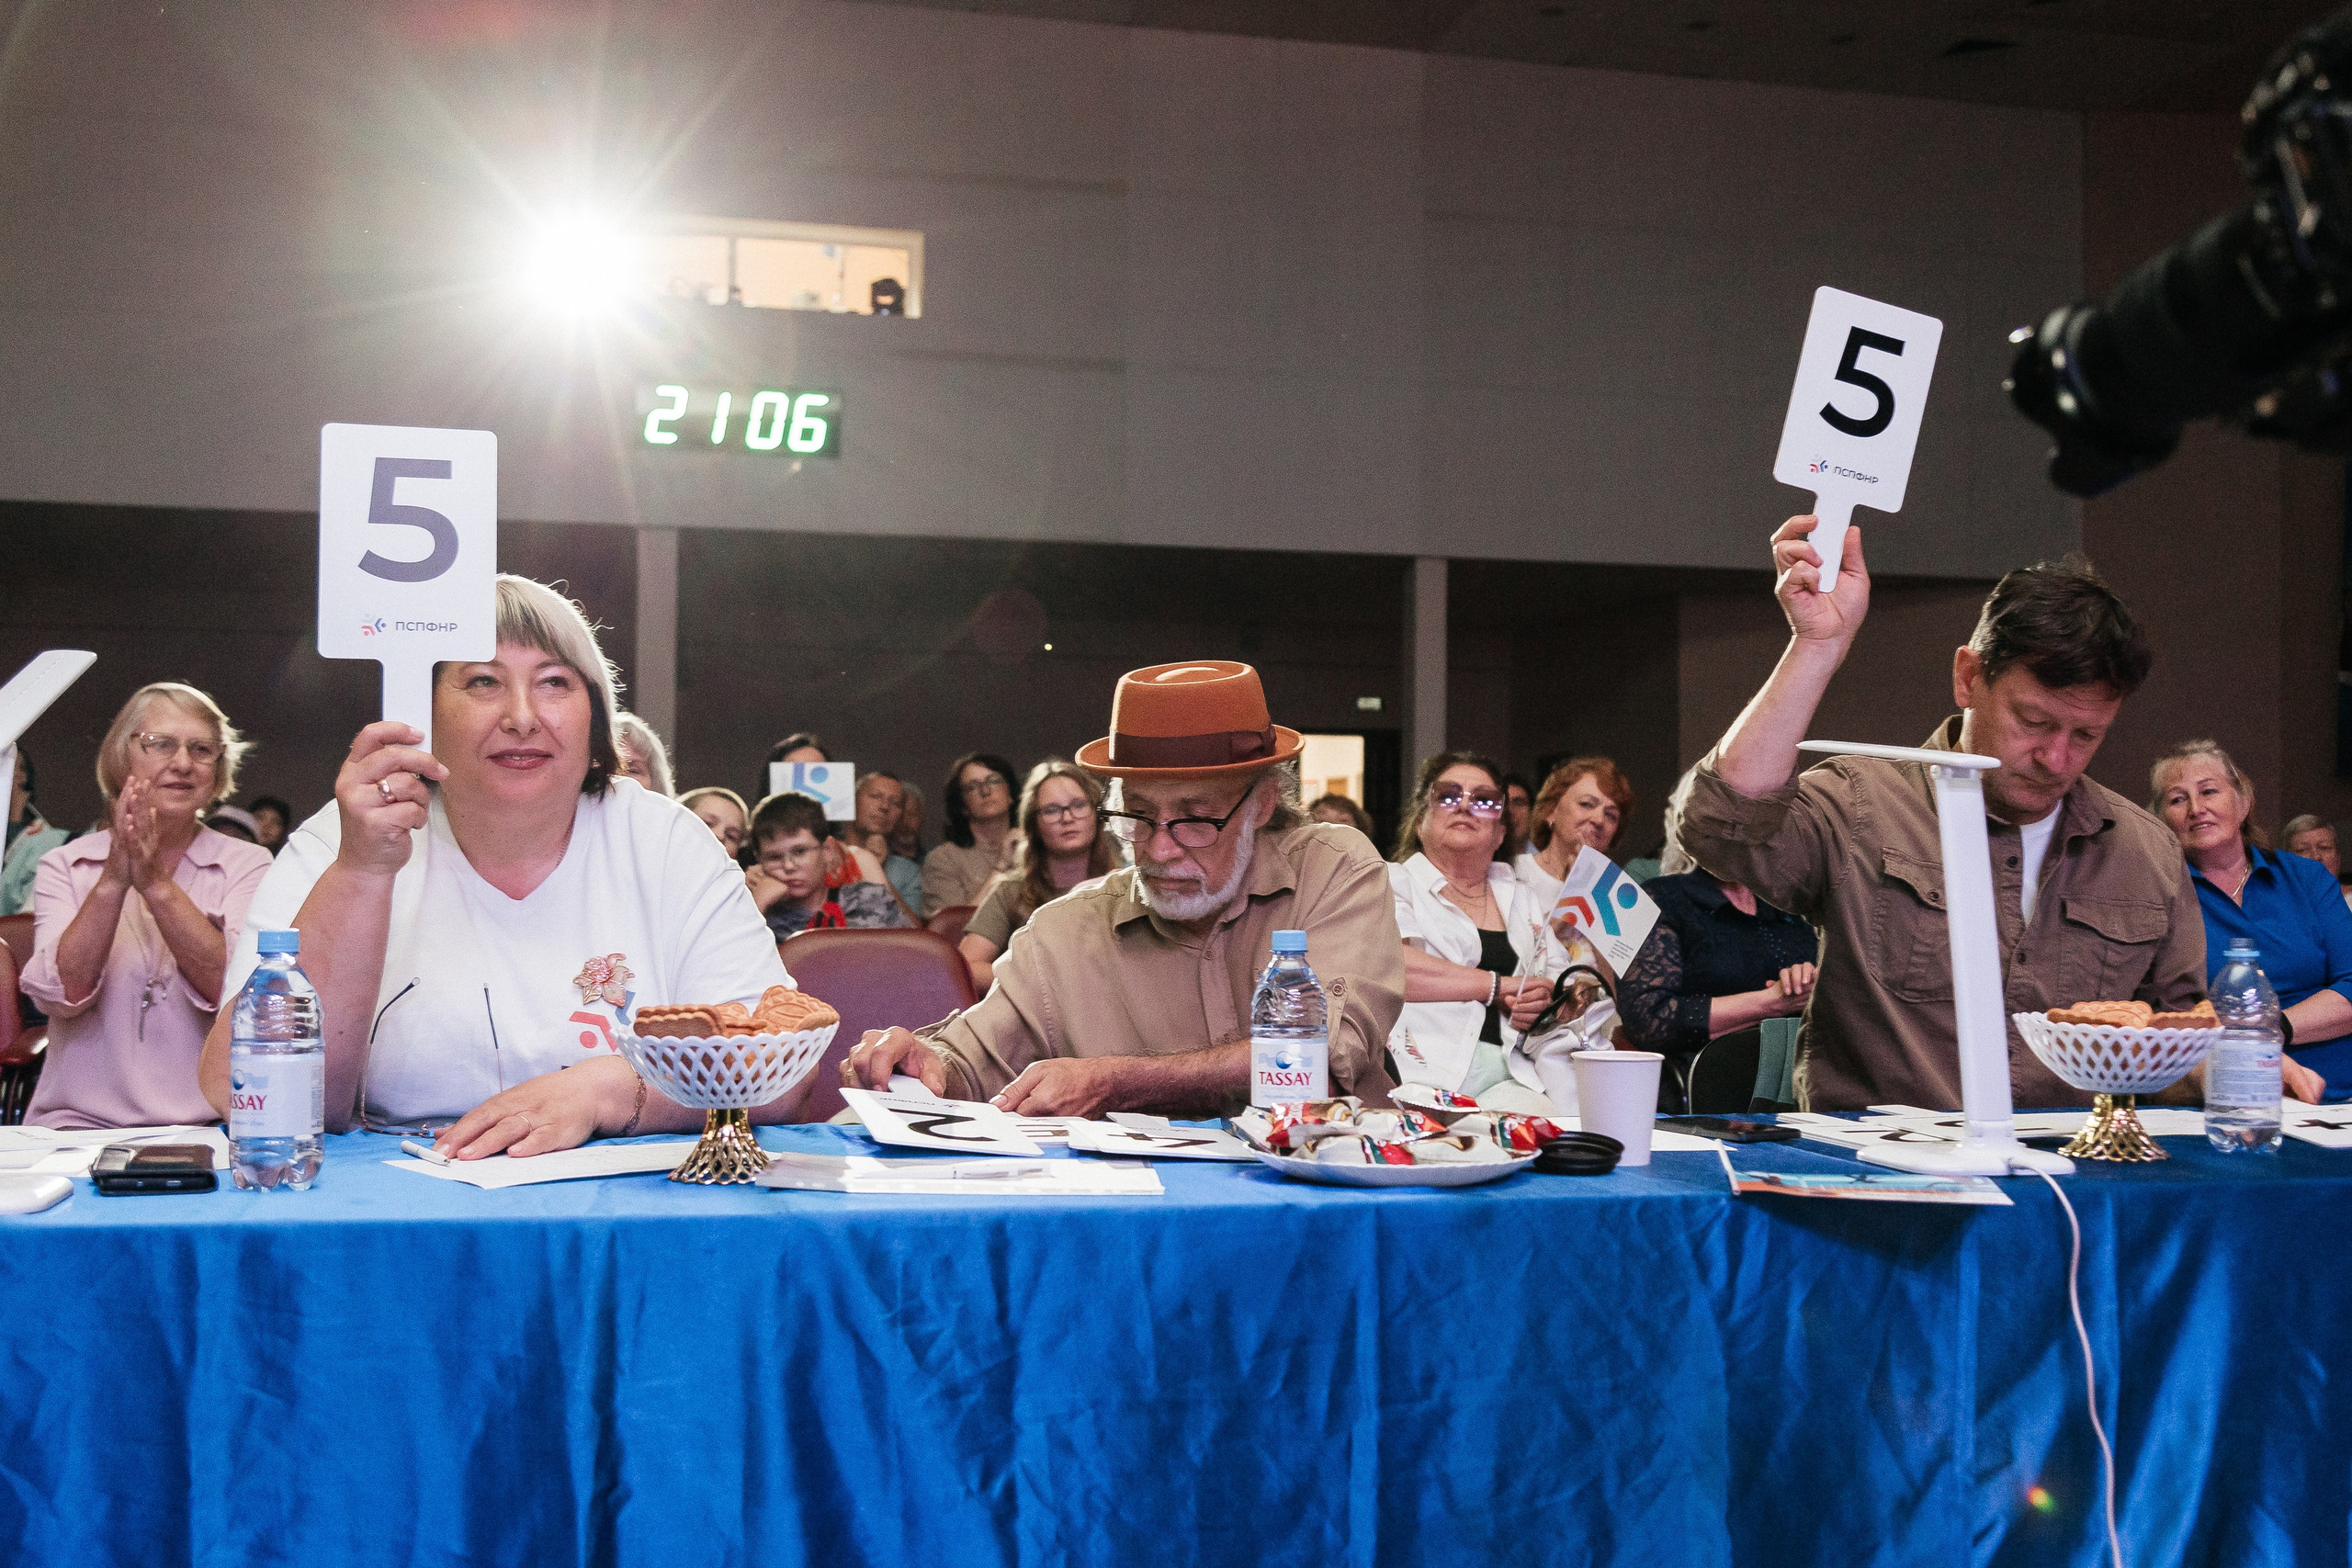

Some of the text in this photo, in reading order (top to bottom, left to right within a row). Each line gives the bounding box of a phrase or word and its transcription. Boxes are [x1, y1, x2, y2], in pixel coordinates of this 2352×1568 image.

[1819, 325, 1906, 438] 5
[1833, 465, 1880, 484] ПСПФНР
[358, 457, 459, 582] 5
[394, 620, 458, 632] ПСПФНР
[1258, 1071, 1313, 1086] TASSAY
[230, 1093, 267, 1111] SSAY
[888, 1108, 1000, 1142] 2
